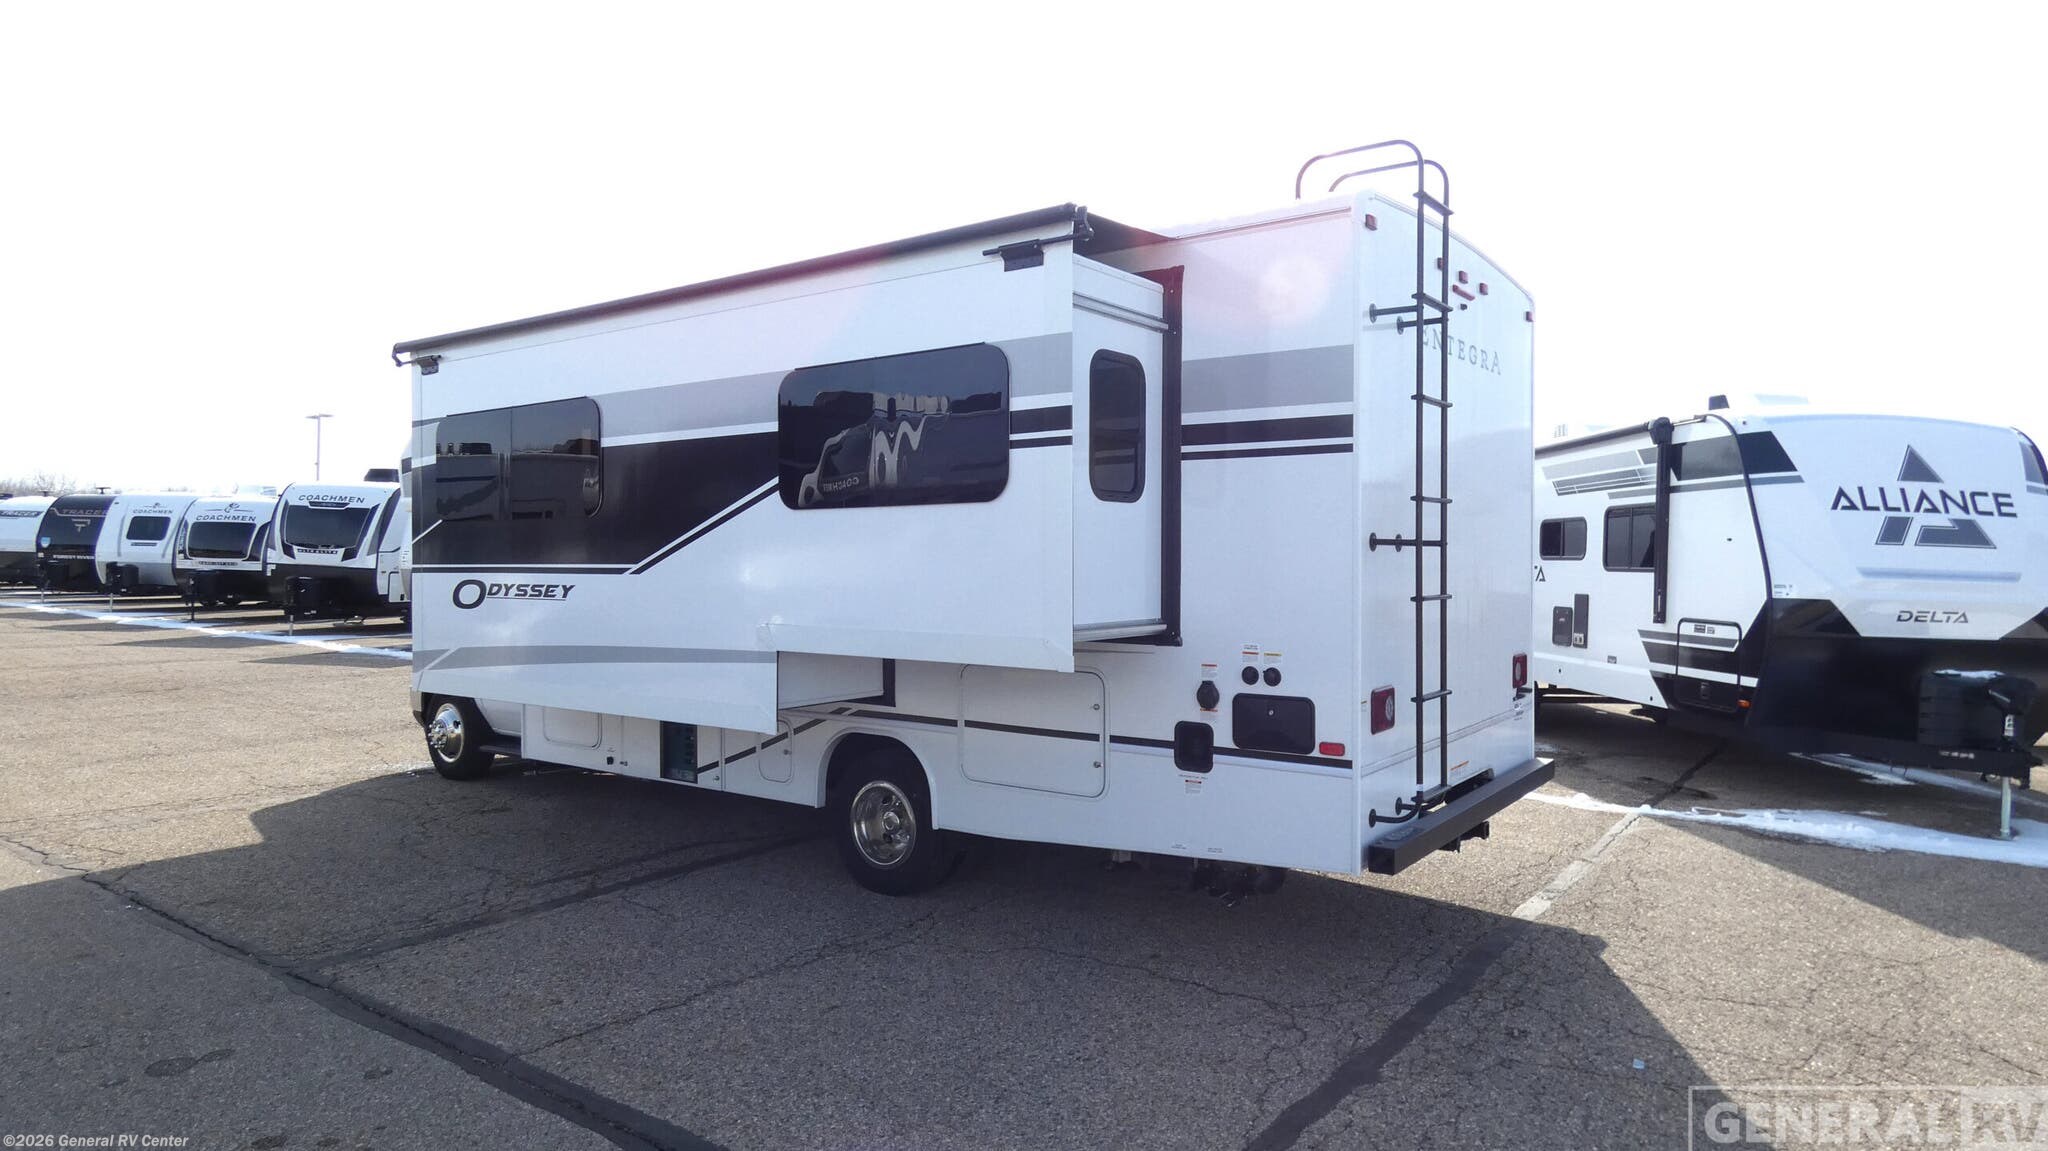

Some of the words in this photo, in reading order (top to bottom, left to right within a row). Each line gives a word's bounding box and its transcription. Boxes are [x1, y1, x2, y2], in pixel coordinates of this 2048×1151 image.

[1422, 325, 1502, 376] ENTEGRA
[298, 494, 365, 503] COACHMEN
[1830, 485, 2018, 519] ALLIANCE
[196, 514, 257, 522] COACHMEN
[452, 579, 576, 609] ODYSSEY
[1896, 610, 1969, 624] DELTA
